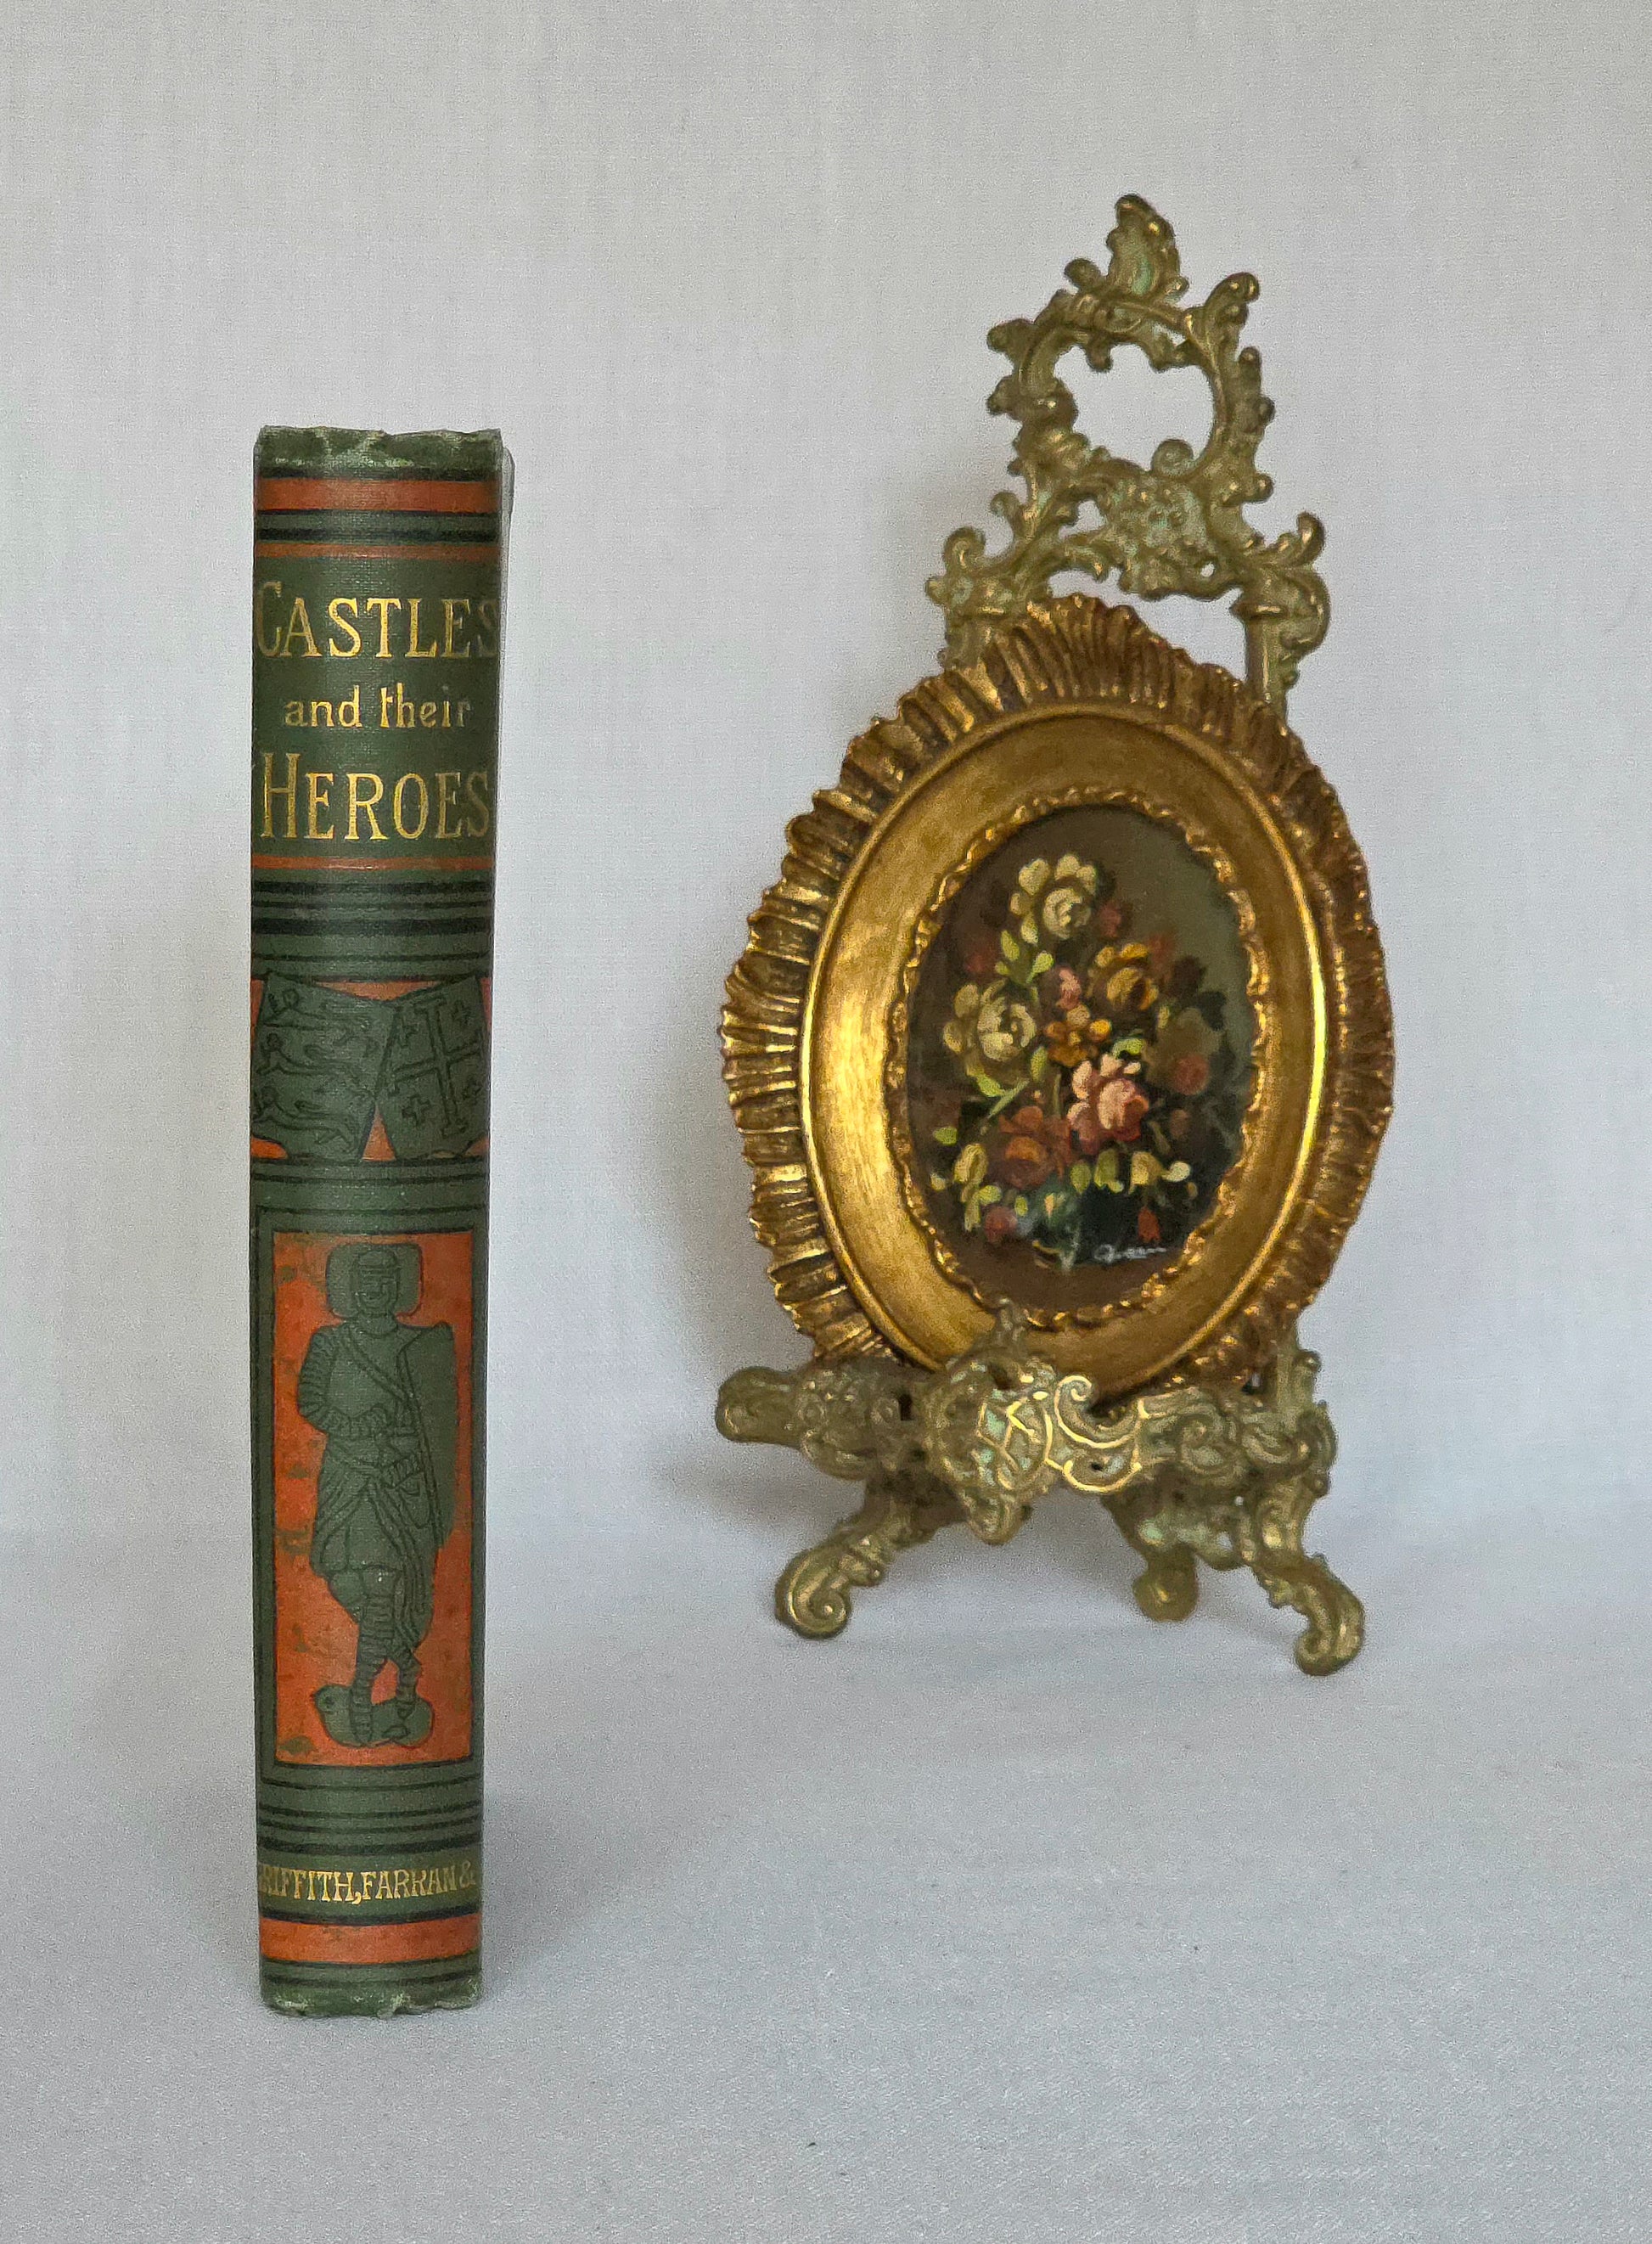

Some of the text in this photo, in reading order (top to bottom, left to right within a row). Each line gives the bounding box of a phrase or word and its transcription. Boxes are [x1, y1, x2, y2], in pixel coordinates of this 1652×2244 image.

[256, 581, 498, 658] CASTLES
[284, 682, 471, 728] and their
[260, 752, 490, 840] HEROES
